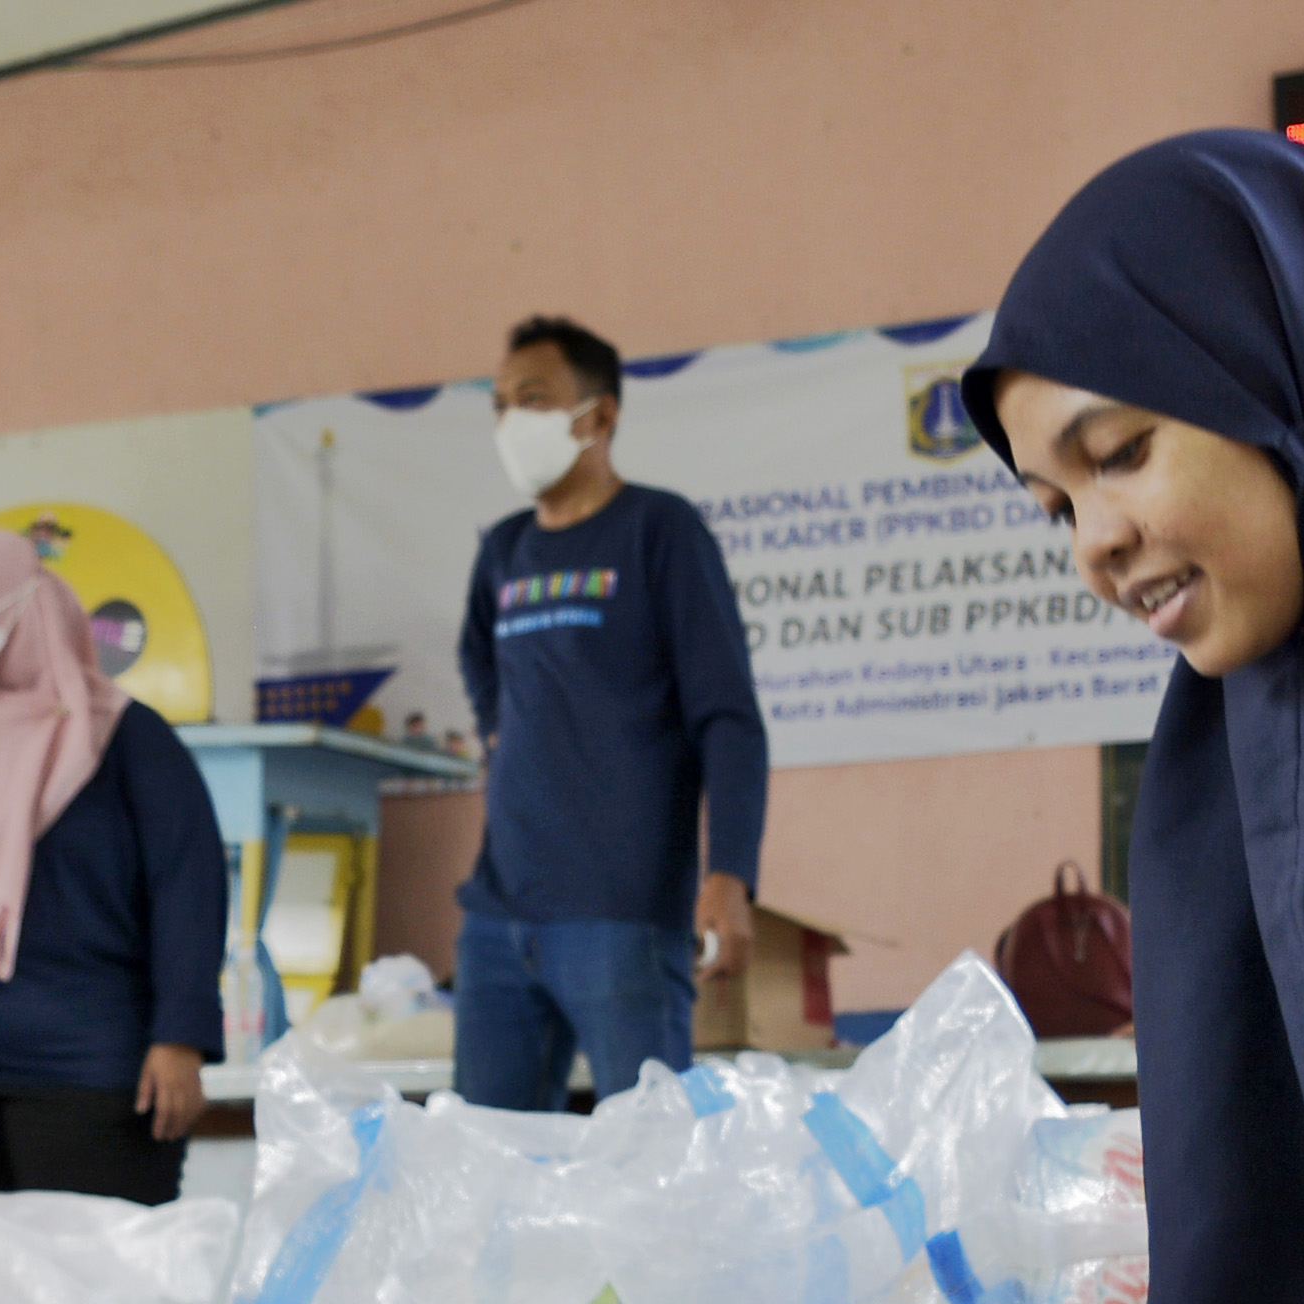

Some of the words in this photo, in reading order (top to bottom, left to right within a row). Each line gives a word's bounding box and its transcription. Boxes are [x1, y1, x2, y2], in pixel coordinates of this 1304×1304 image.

[863, 548, 1080, 595] PELAKSAN
[781, 614, 863, 650] DAN
[877, 603, 951, 641] SUB
